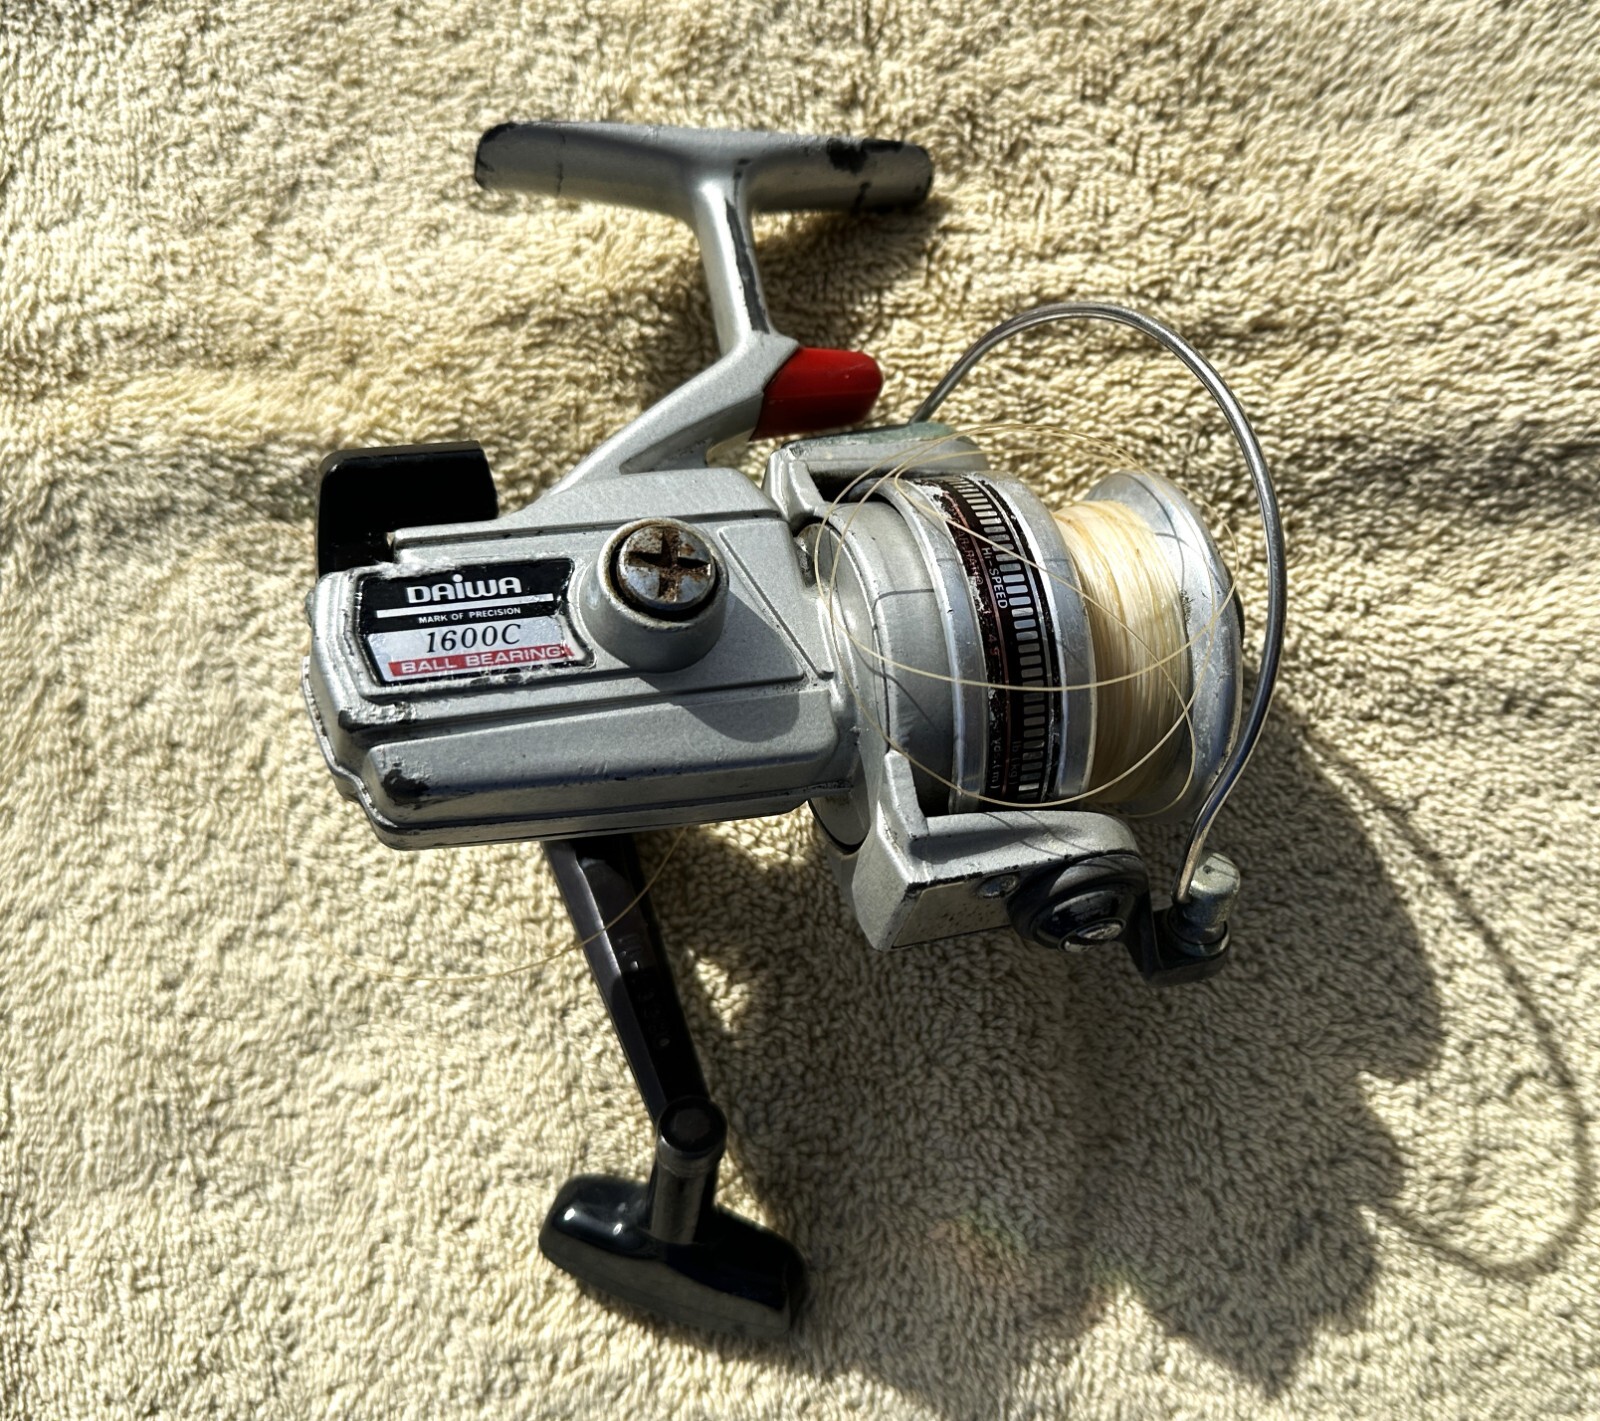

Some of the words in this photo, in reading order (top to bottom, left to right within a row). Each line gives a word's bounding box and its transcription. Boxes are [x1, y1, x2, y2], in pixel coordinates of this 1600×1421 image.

[981, 547, 1009, 609] Hi-SPEED
[418, 614, 448, 624] MARK
[451, 612, 464, 621] OF
[469, 607, 521, 619] PRECISION
[426, 623, 522, 654] 1600C
[401, 657, 458, 675] BALL
[465, 645, 562, 668] BEARING
